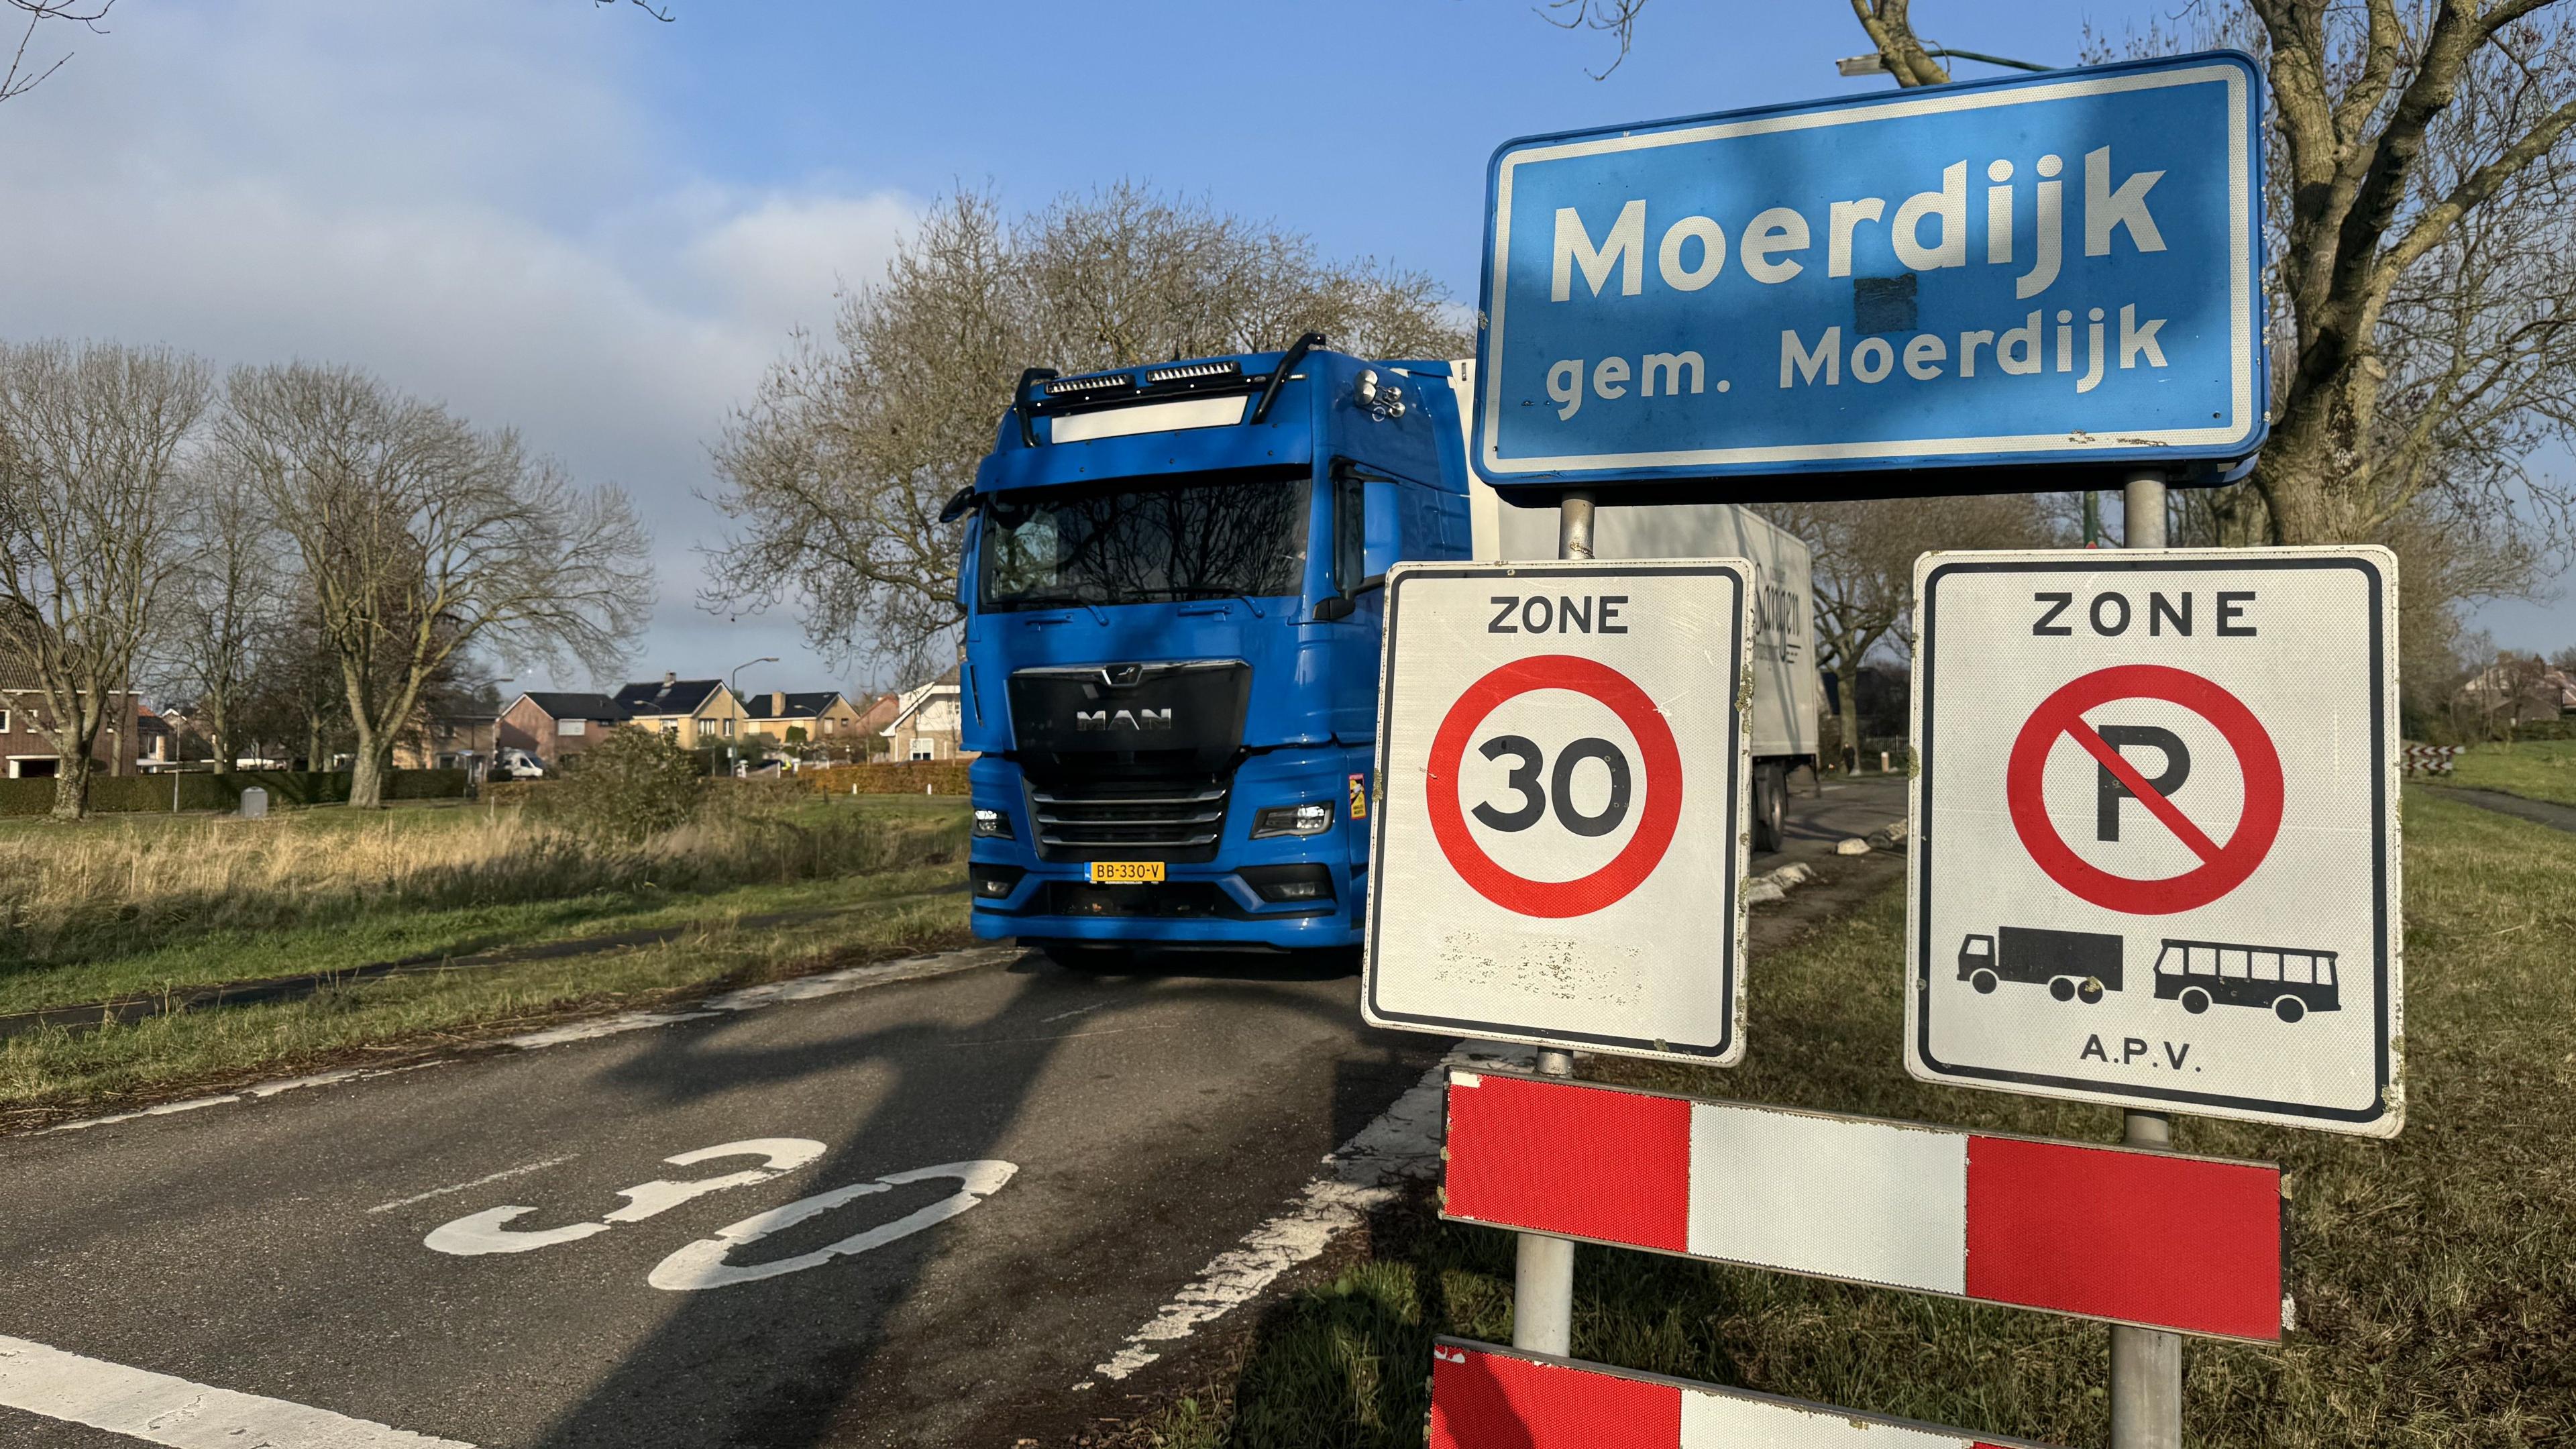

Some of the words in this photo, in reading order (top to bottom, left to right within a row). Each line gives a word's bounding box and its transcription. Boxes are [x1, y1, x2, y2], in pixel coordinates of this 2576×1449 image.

[1550, 146, 2167, 302] Moerdijk
[1546, 351, 1731, 421] gem.
[1780, 304, 2168, 393] Moerdijk
[1488, 596, 1629, 634] ZONE
[2033, 591, 2257, 637] ZONE
[1077, 708, 1171, 731] MAN
[1471, 735, 1631, 837] 30
[2097, 725, 2191, 842] P
[1097, 864, 1159, 878] BB-330-V
[2080, 1034, 2201, 1072] A.P.V.
[423, 1138, 1019, 1290] 30
